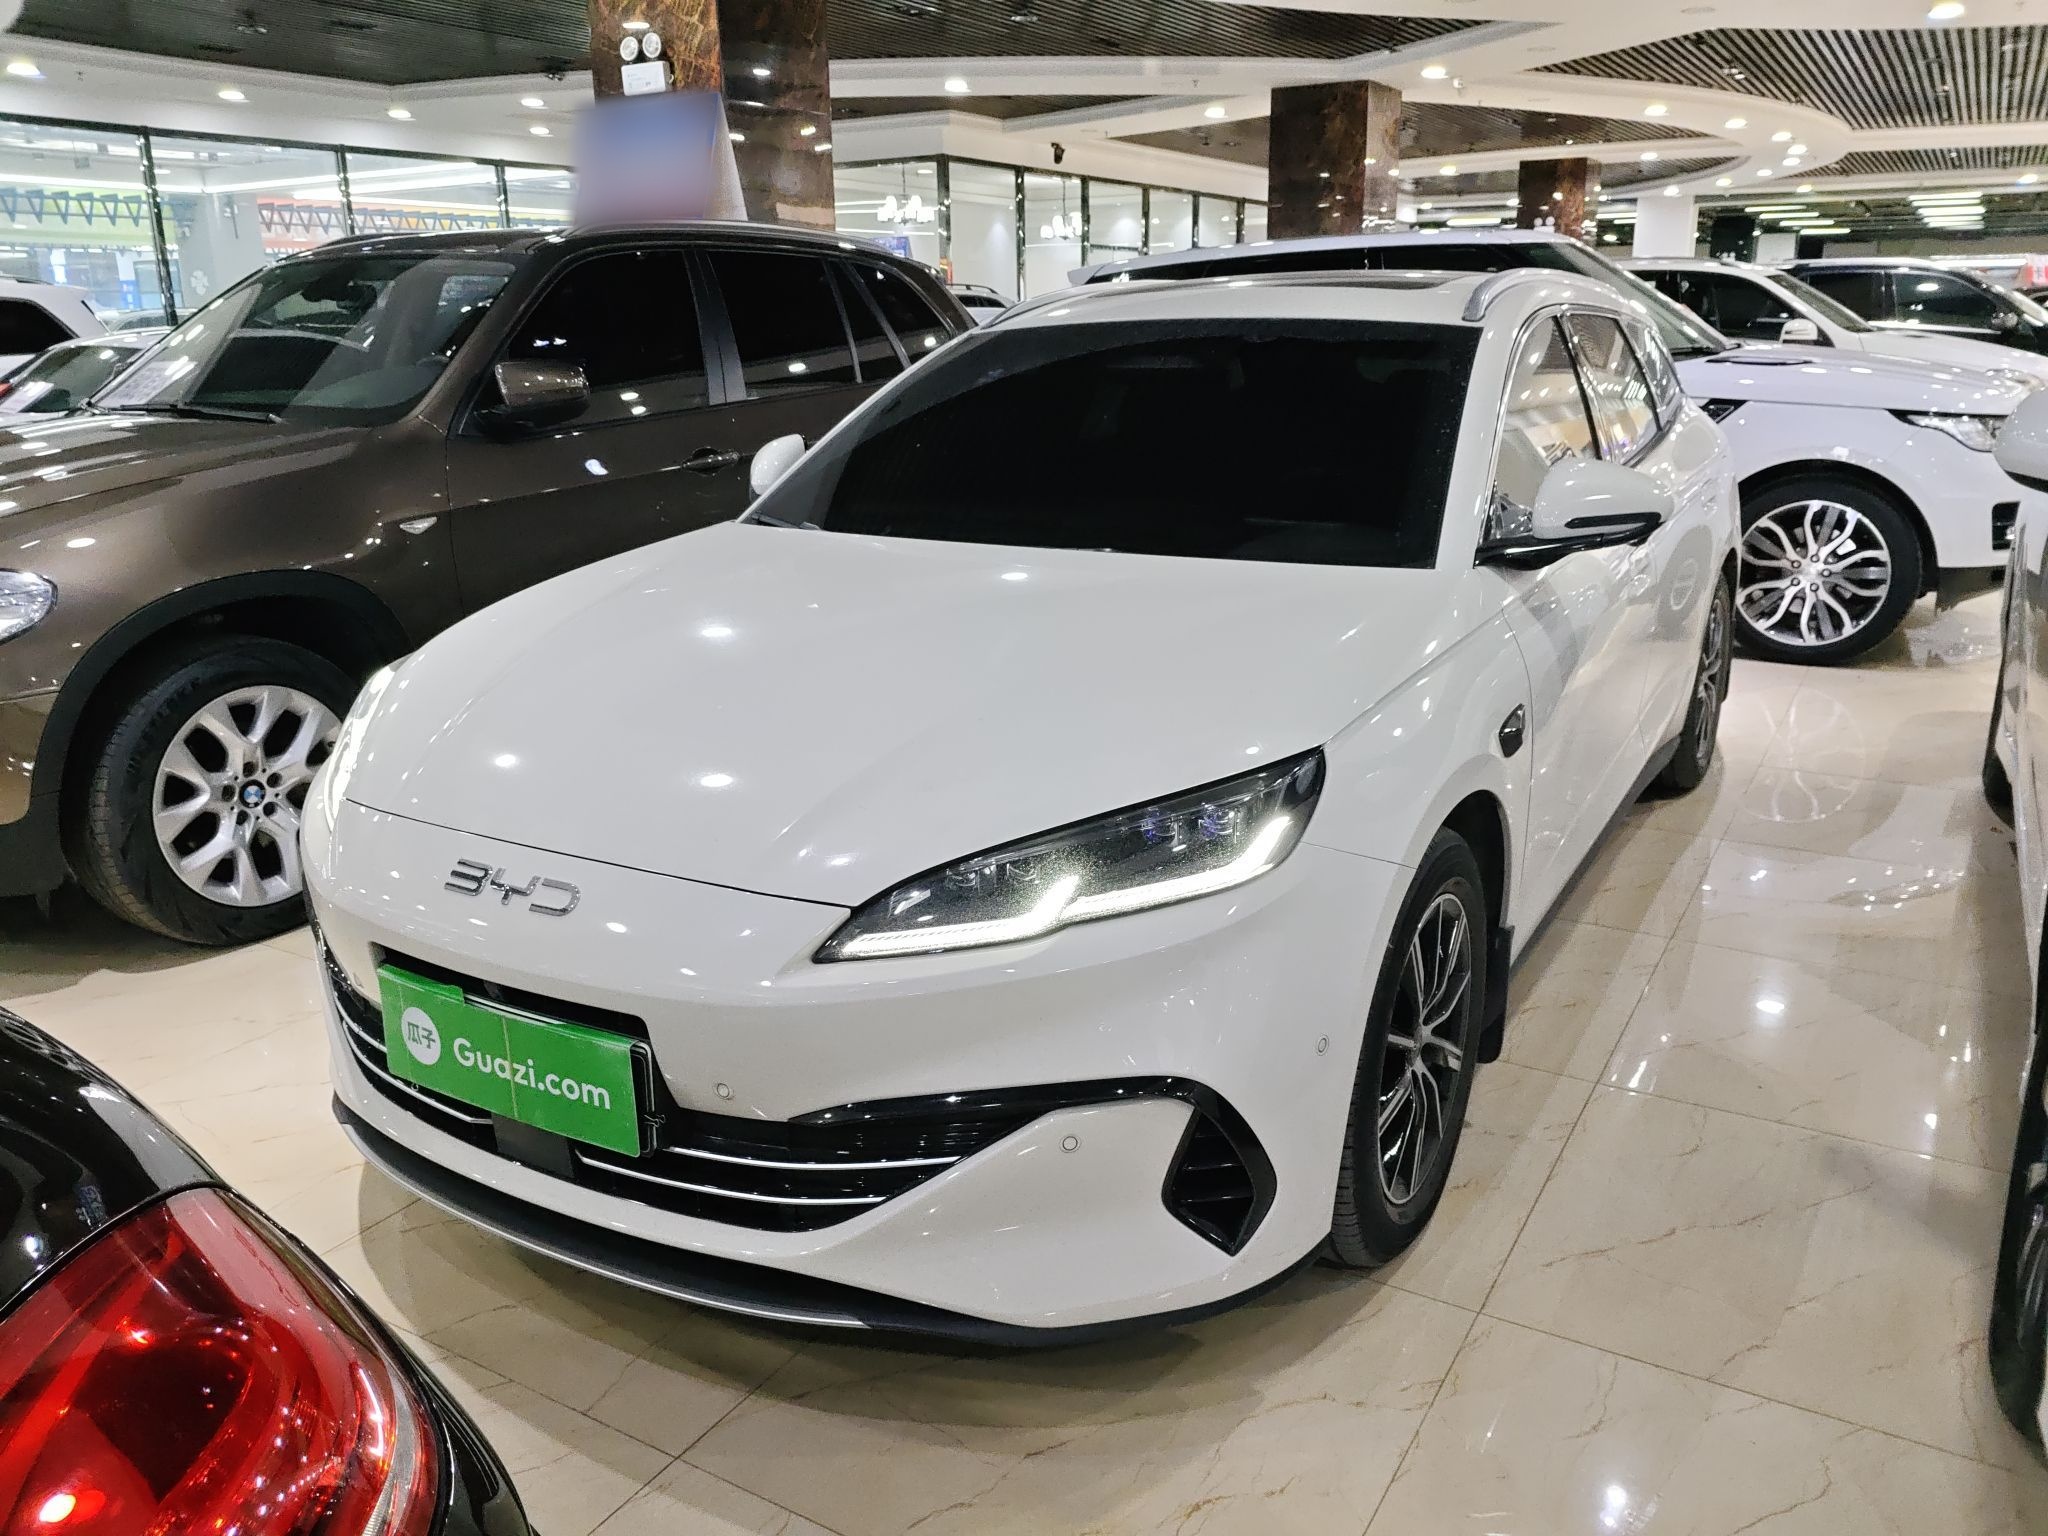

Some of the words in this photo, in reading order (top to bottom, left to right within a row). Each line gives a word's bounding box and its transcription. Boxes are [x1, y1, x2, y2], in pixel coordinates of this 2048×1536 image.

[444, 858, 581, 917] BYD
[407, 1021, 436, 1049] 瓜子
[453, 1037, 611, 1110] Guazi.com
